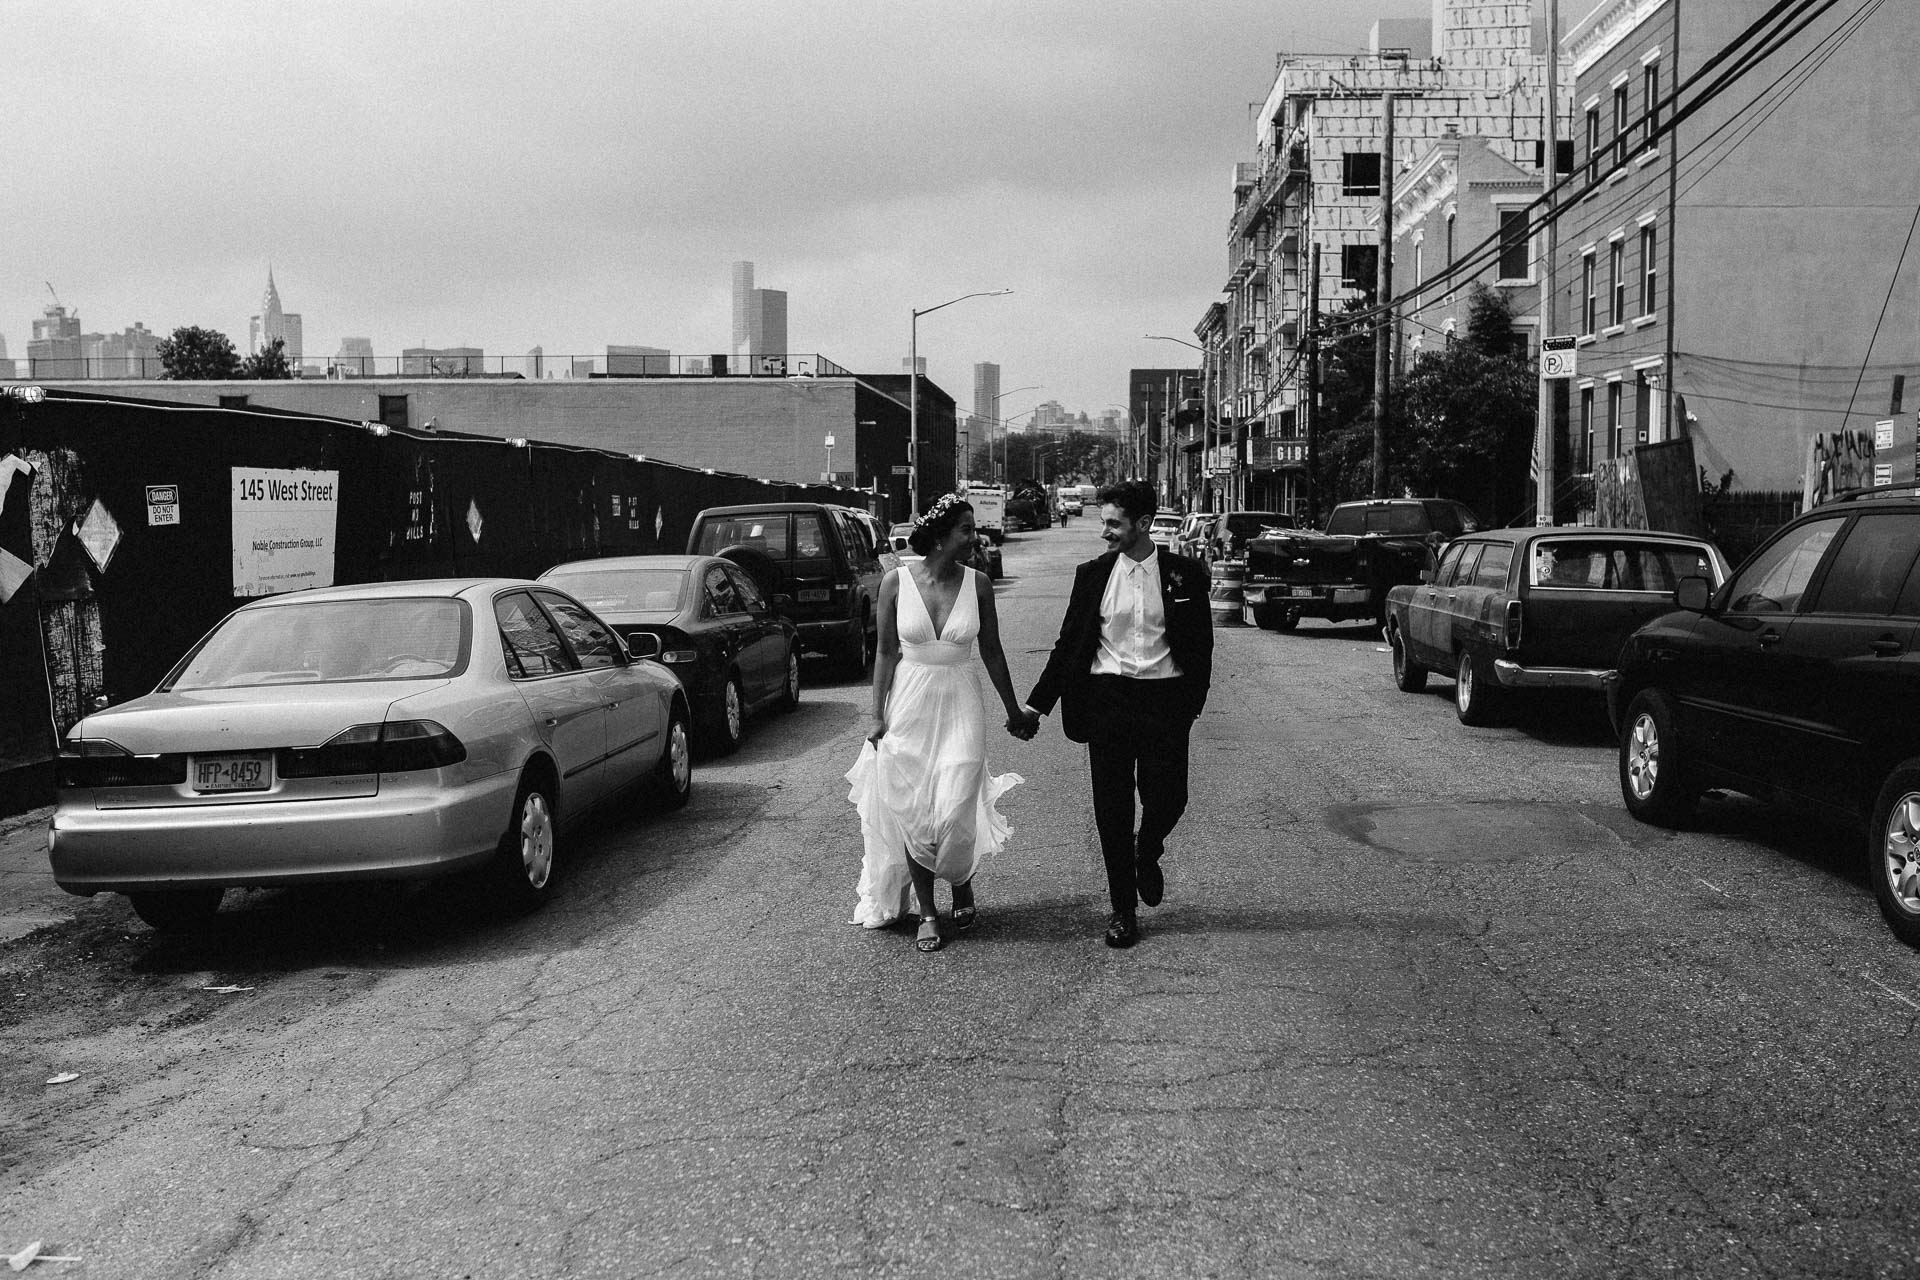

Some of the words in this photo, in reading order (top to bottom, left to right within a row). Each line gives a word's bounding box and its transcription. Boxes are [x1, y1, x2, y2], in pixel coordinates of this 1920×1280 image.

[151, 491, 174, 501] DANGER
[240, 478, 264, 501] 145
[268, 479, 298, 501] West
[301, 480, 333, 501] Street
[409, 491, 422, 505] POST
[152, 506, 161, 514] DO
[162, 505, 174, 514] NOT
[154, 513, 174, 522] ENTER
[406, 525, 424, 540] BILLS
[252, 540, 269, 551] Noble
[269, 538, 300, 550] Construction
[300, 538, 314, 550] Group,
[315, 537, 323, 547] LLC
[198, 762, 222, 783] HFP
[230, 761, 261, 783] 8459
